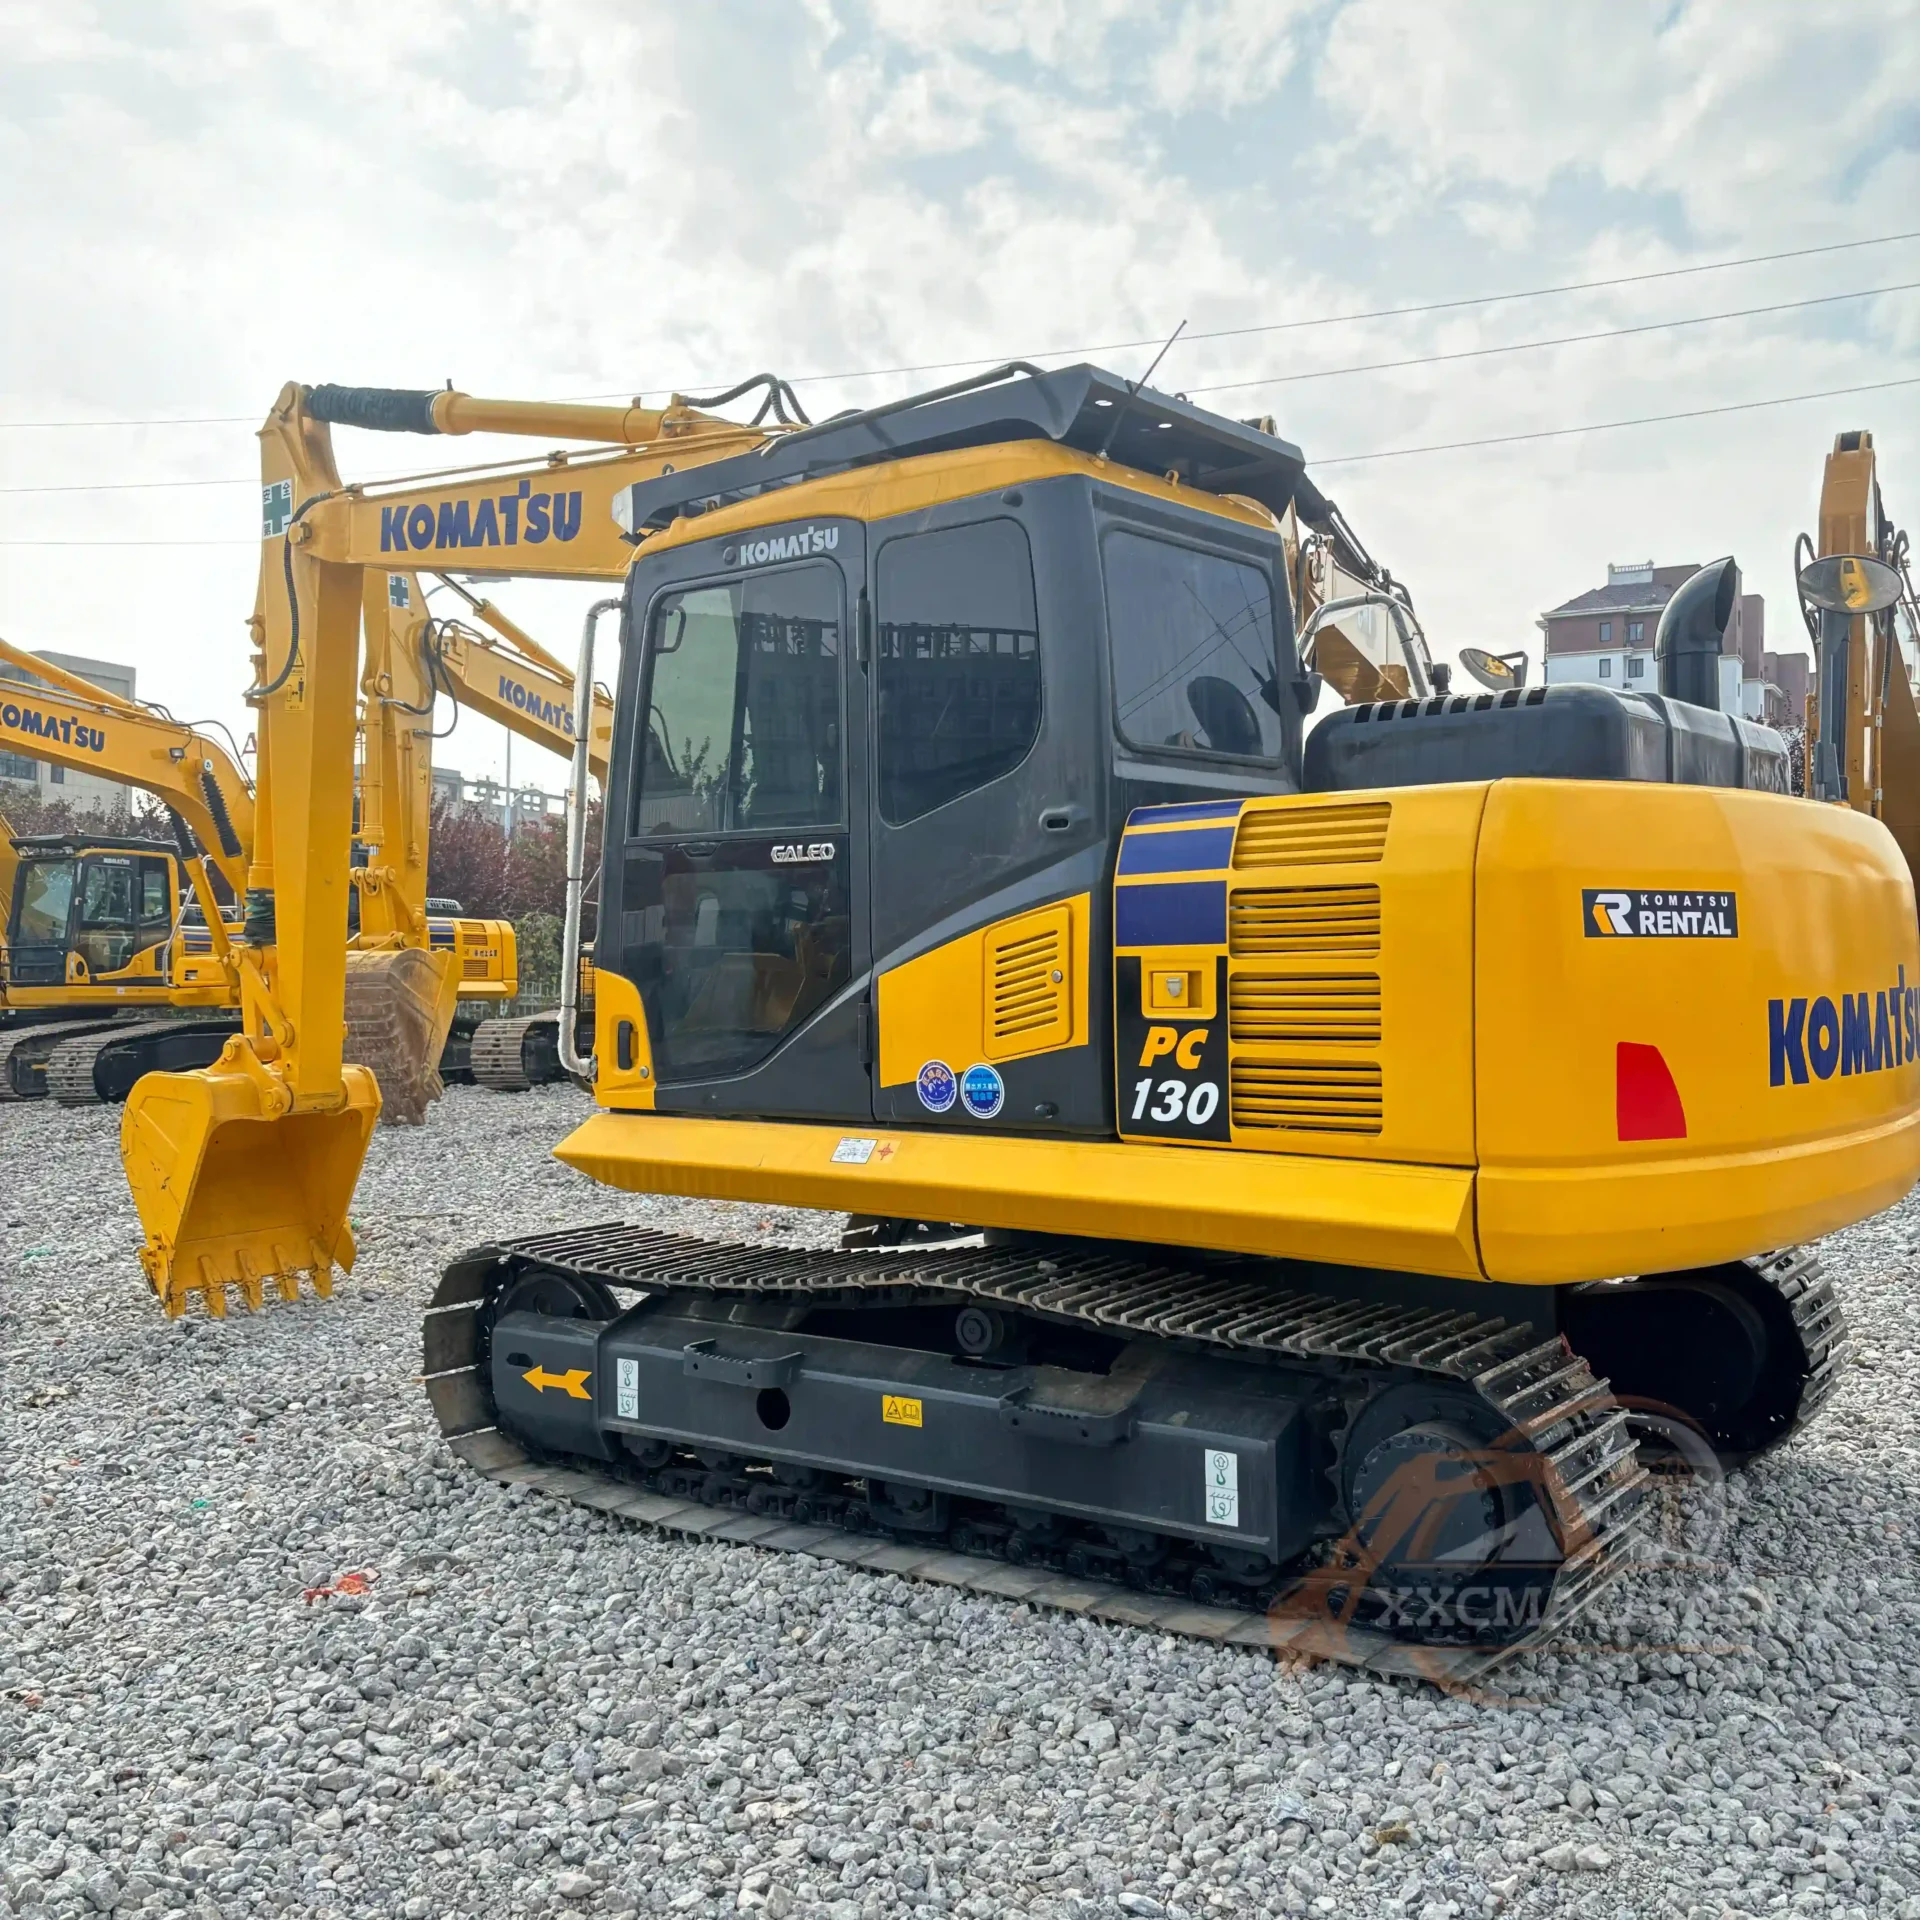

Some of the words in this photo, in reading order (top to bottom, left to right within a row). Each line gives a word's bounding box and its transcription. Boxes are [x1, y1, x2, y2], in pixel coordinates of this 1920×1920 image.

[380, 479, 583, 552] KOMATSU
[740, 526, 839, 566] KOMATSU
[0, 702, 105, 752] OMATSU
[498, 675, 576, 735] KOMATS
[771, 843, 835, 863] GALEO
[1639, 910, 1731, 935] RENTAL
[1640, 894, 1728, 907] KOMATSU
[1138, 1026, 1209, 1070] PC
[1131, 1078, 1219, 1125] 130
